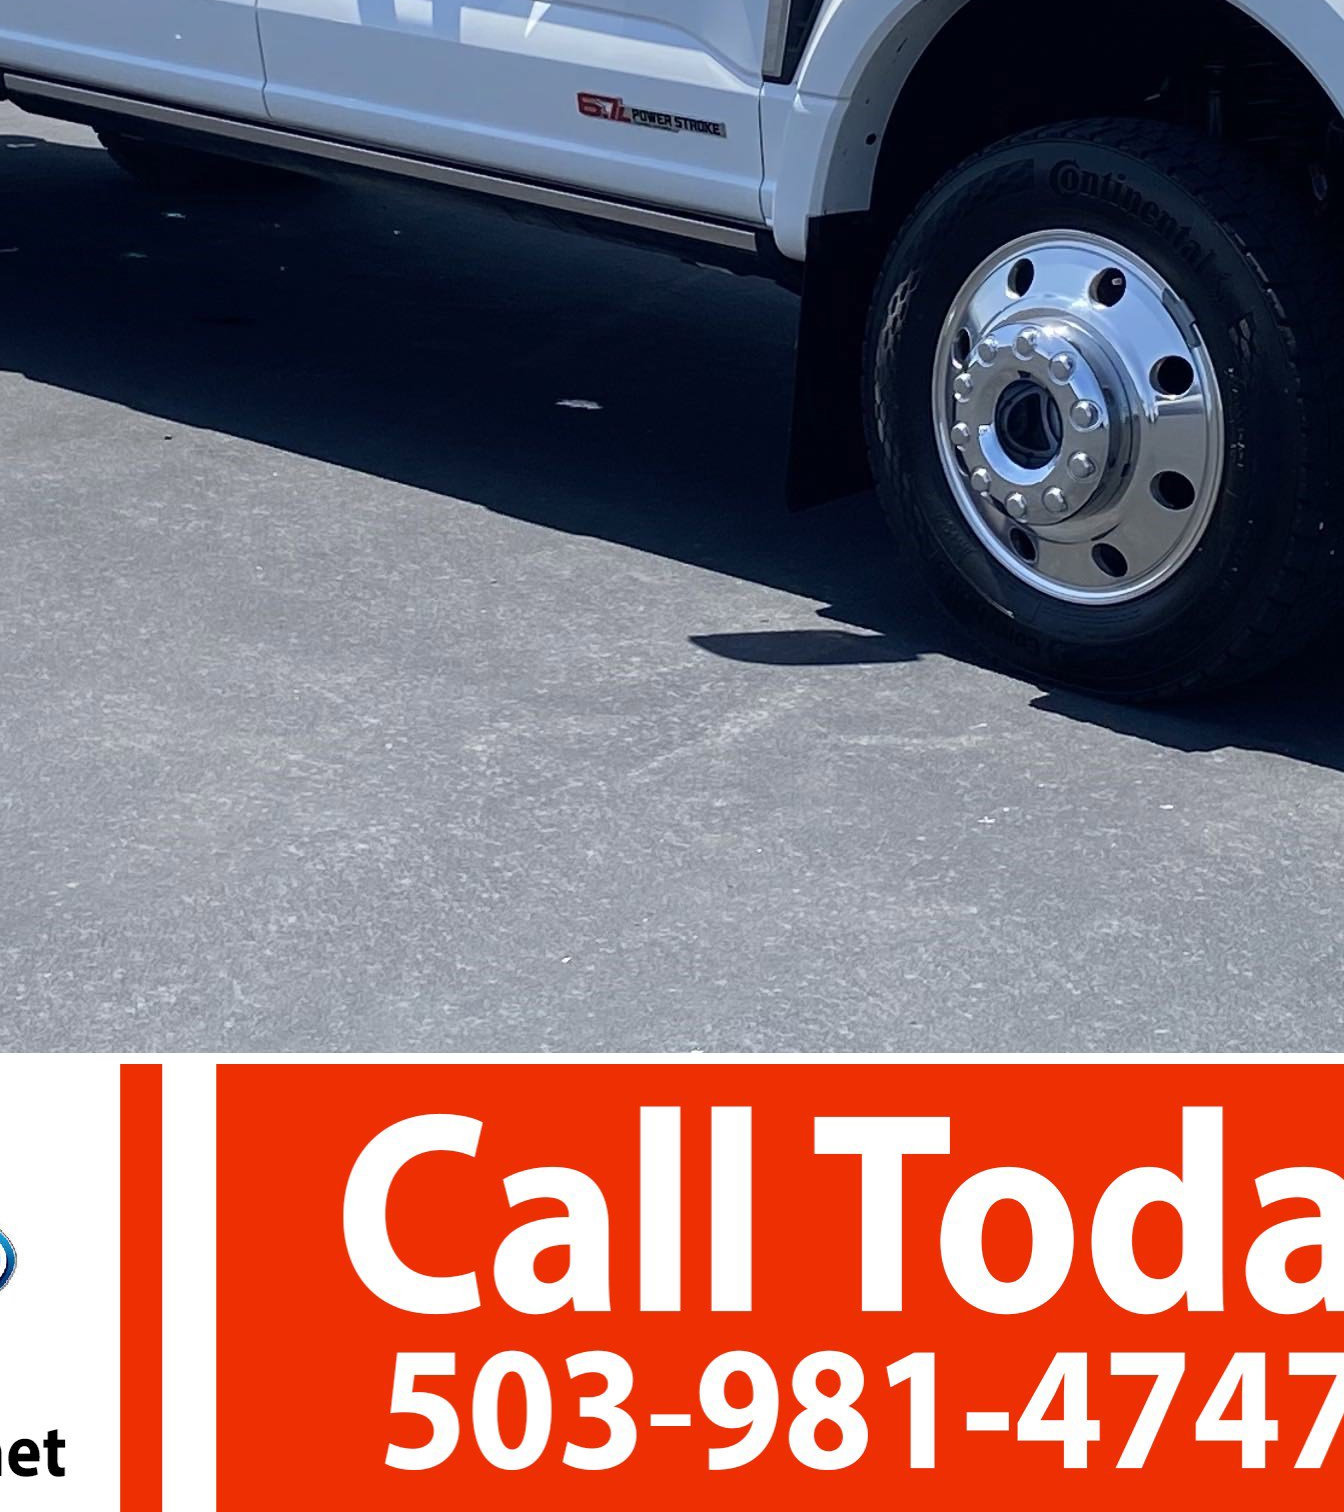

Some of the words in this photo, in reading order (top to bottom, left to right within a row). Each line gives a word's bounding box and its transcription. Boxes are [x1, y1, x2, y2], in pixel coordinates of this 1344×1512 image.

[631, 107, 673, 128] POWER
[673, 115, 722, 137] STROKE
[1049, 159, 1216, 276] Continental
